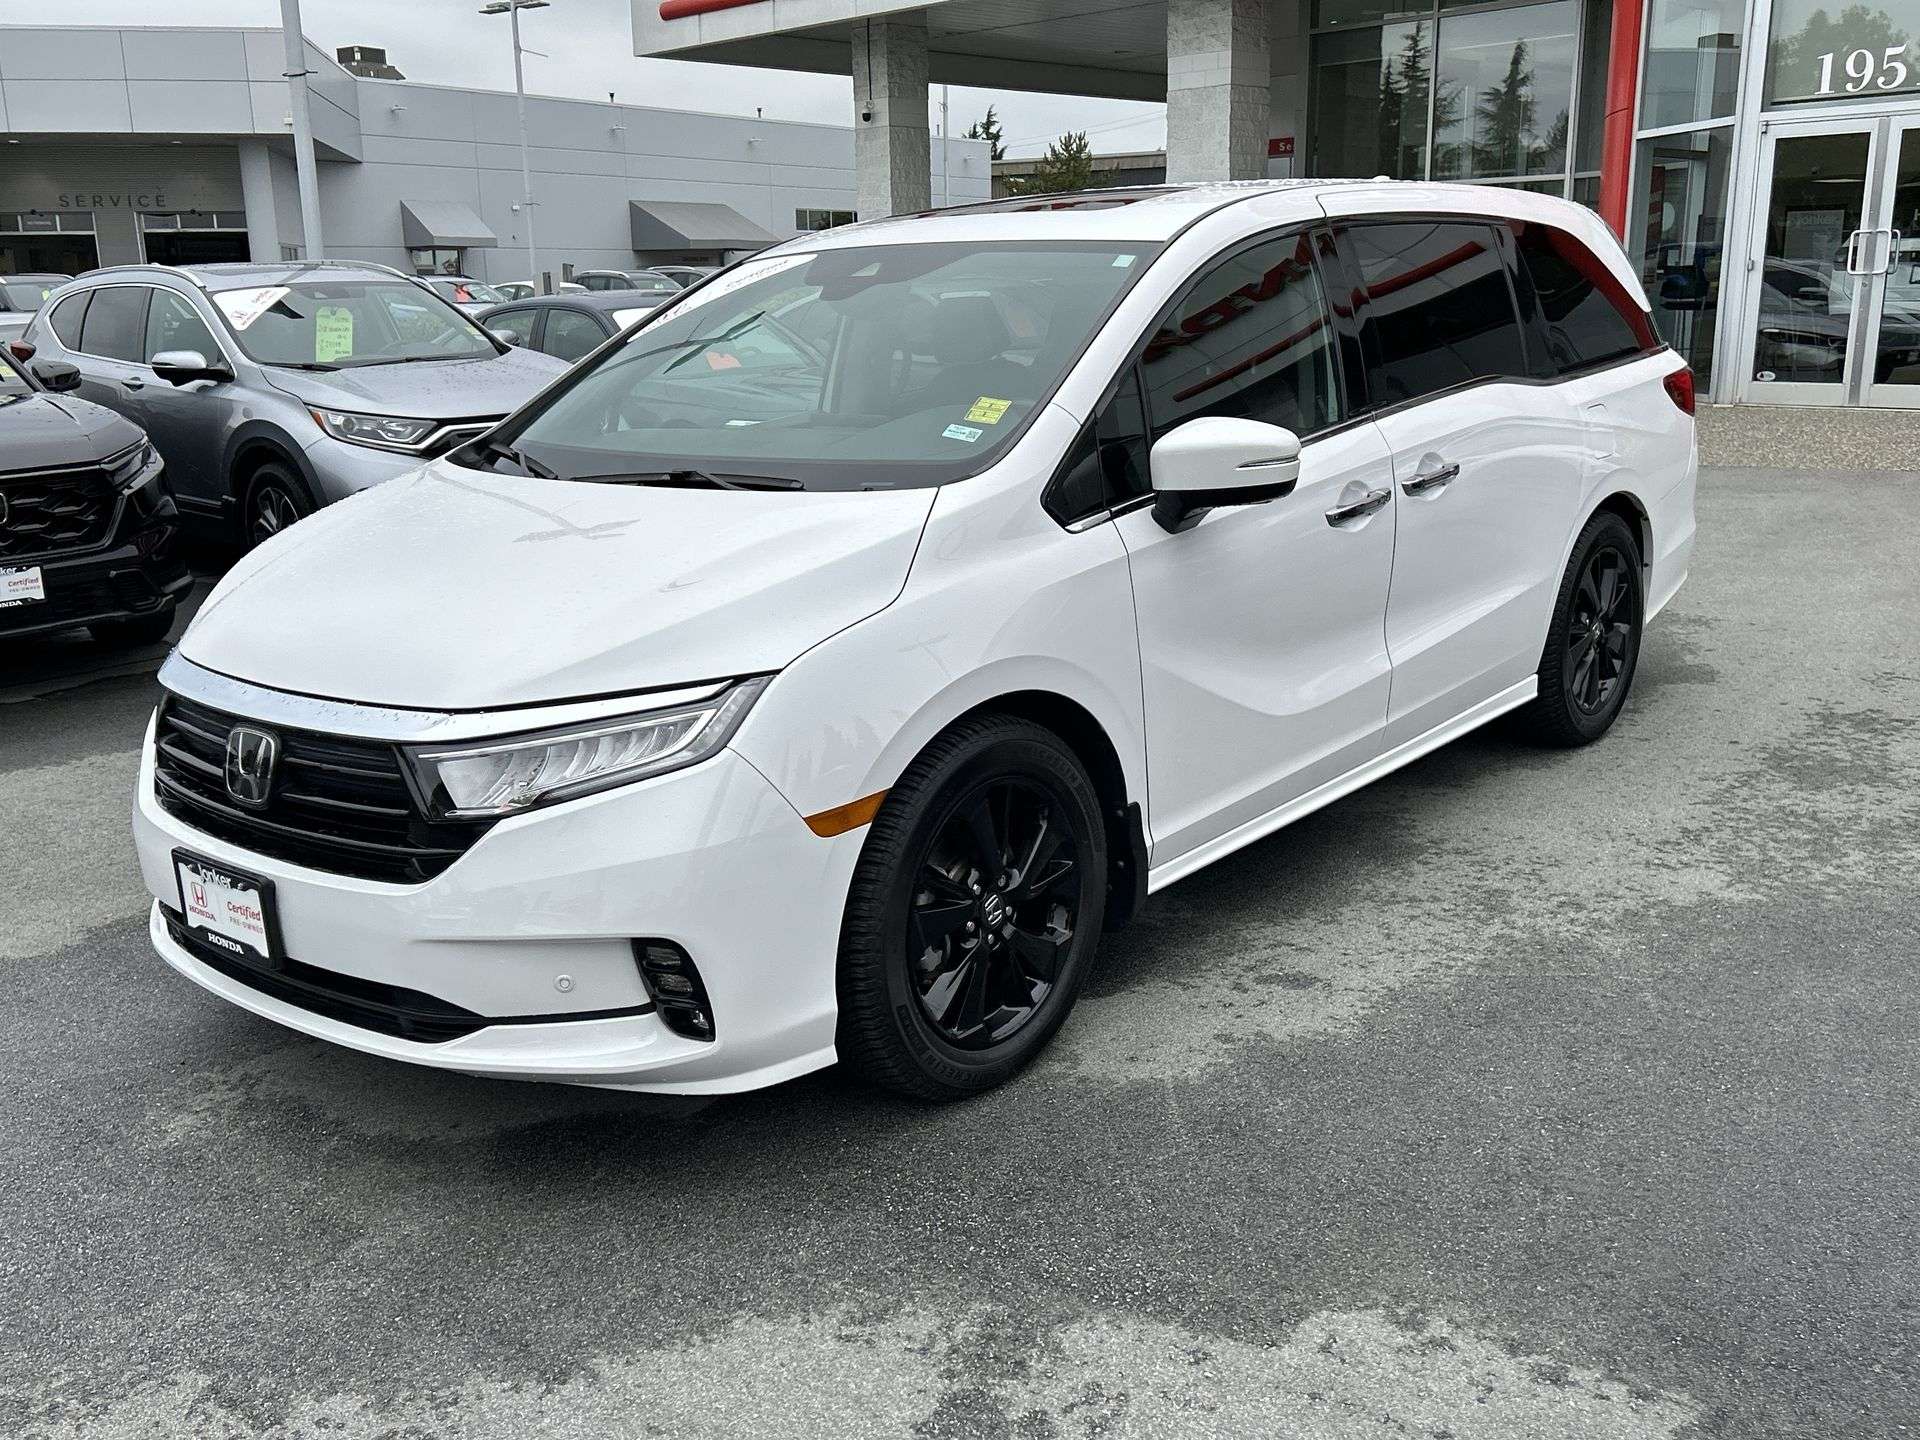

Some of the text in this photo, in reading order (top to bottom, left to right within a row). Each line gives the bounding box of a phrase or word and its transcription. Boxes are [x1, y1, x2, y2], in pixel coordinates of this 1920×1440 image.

[1815, 43, 1920, 94] 195
[58, 194, 166, 208] SERVICE
[0, 600, 23, 608] NDA
[189, 904, 217, 922] HONDA
[227, 901, 261, 921] Certified
[208, 931, 245, 955] HONDA
